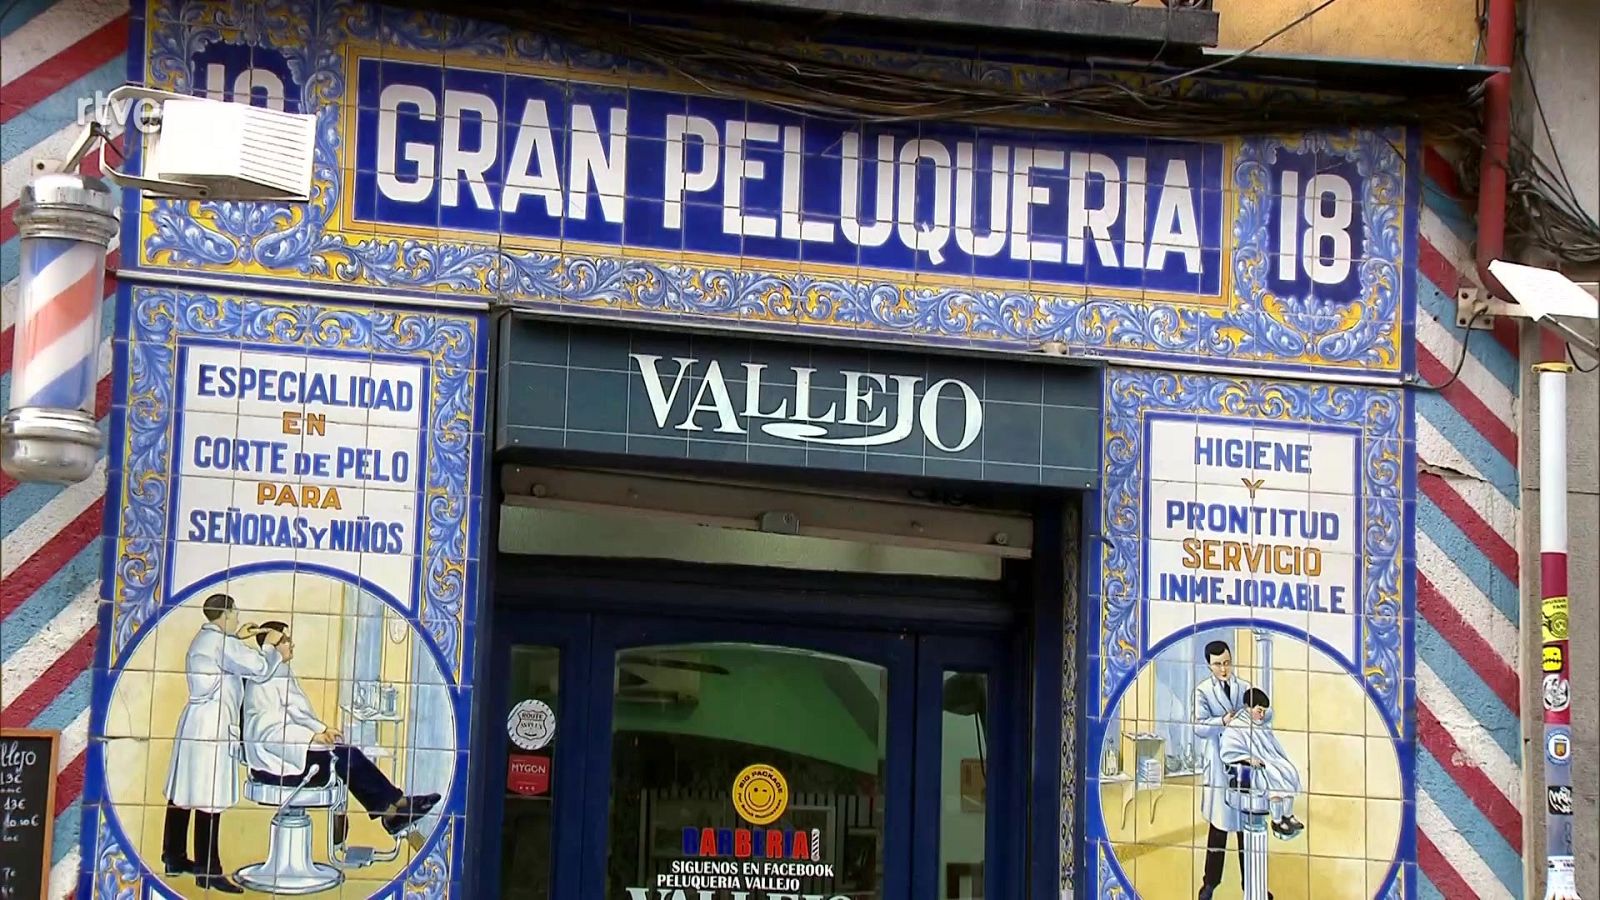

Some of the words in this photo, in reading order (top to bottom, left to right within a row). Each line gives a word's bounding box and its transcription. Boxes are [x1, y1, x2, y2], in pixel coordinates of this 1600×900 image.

[376, 83, 627, 225] GRAN
[662, 113, 1203, 275] PELUQUERIA
[1278, 170, 1354, 286] 18
[197, 363, 413, 413] ESPECIALIDAD
[630, 352, 984, 453] VALLEJO
[282, 410, 326, 437] EN
[193, 435, 288, 475] CORTE
[336, 446, 409, 483] PELO
[1193, 436, 1313, 475] HIGIENE
[256, 482, 342, 511] PARA
[1240, 477, 1266, 500] Y
[188, 506, 309, 550] SEÑORAS
[329, 515, 405, 556] NIÑOS
[1165, 499, 1340, 542] PRONTITUD
[1181, 537, 1323, 577] SERVICIO
[1159, 572, 1347, 615] INMEJORABLE
[510, 763, 546, 774] MYGON
[656, 874, 741, 890] PELUQUERIA
[744, 876, 800, 892] VALLEJO
[671, 860, 739, 876] SIGUENOS
[742, 862, 760, 876] EN
[763, 863, 835, 878] FACEBOOK
